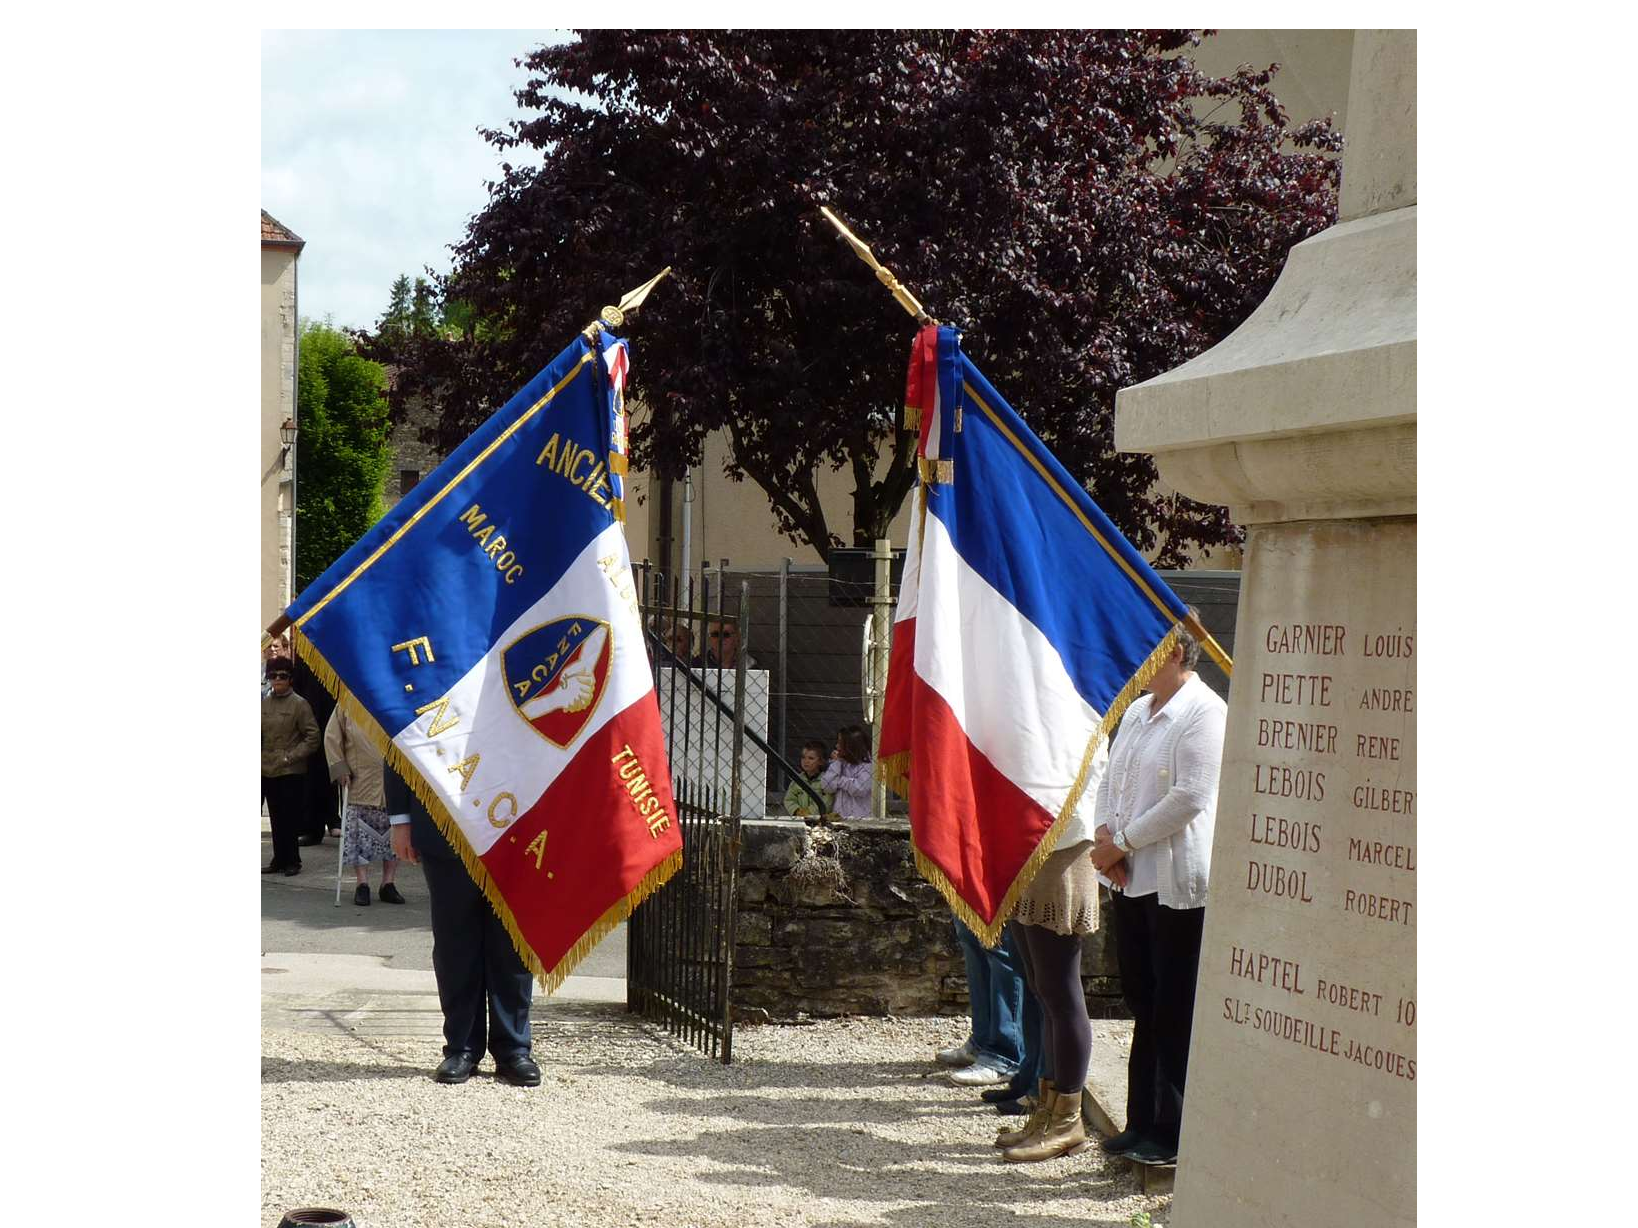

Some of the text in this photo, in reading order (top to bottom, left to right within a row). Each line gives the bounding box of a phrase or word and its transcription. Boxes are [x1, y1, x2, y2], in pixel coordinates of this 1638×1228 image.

[536, 432, 613, 510] ANCIE
[459, 503, 524, 585] MAROC
[514, 621, 582, 698] FNACA
[1266, 624, 1347, 656] GARNIER
[1261, 673, 1414, 713] PIETTE ANDRE
[1257, 719, 1400, 761] BRENIER RENE
[611, 744, 671, 839] TUNISIE
[1254, 765, 1417, 815] LEBOIS GILBER
[1250, 814, 1416, 871] LEBOIS MARCEL
[1246, 861, 1414, 926] DUBOL ROBERT
[1229, 946, 1305, 995] HAPTEL
[1317, 979, 1382, 1016] ROBERT
[1253, 1006, 1341, 1056] SOUDEILLE
